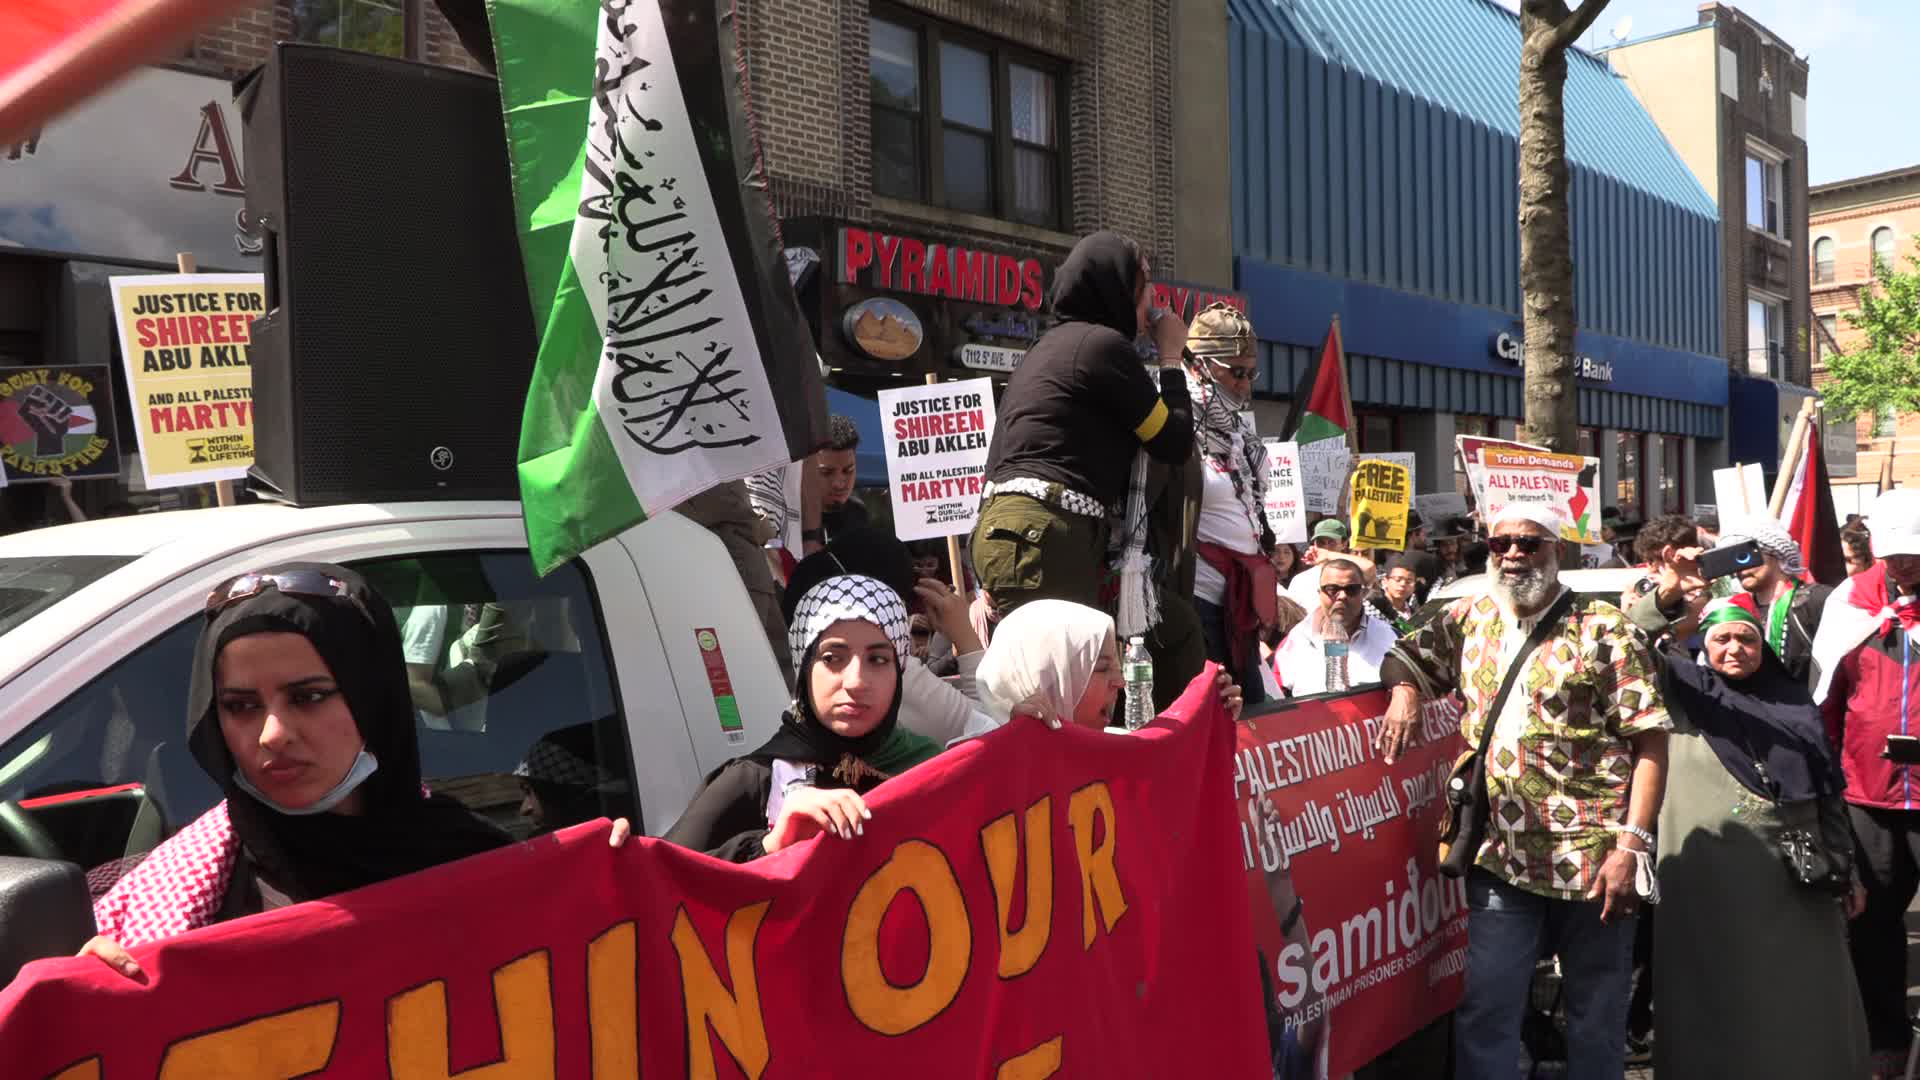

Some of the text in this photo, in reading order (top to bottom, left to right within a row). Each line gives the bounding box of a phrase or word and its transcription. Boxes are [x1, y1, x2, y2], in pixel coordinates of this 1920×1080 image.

[842, 226, 1044, 312] PYRAMIDS
[133, 292, 263, 316] JUSTICE FOR
[143, 348, 192, 373] ABU
[965, 348, 981, 364] 7112
[1582, 357, 1614, 382] Bank
[57, 372, 94, 400] FOR
[148, 391, 174, 406] AND
[178, 389, 200, 403] ALL
[892, 393, 982, 417] JUSTICE FOR
[894, 409, 985, 441] SHIREEN
[207, 434, 244, 445] WITHIN
[207, 443, 230, 453] OUR
[898, 432, 987, 458] ABU AKLEH
[1276, 457, 1292, 467] 74
[1496, 453, 1574, 469] Torah Demands
[901, 465, 987, 482] AND ALL PALESTINIA
[1356, 464, 1404, 491] FREE
[1488, 474, 1510, 488] ALL
[937, 502, 963, 510] WITHIN
[1355, 488, 1404, 504] PALESTINE
[938, 514, 971, 523] LIFETIME
[840, 779, 1129, 1038] OUR
[1284, 984, 1353, 1034] PALESTINIAN
[1353, 956, 1405, 996] PRISONER
